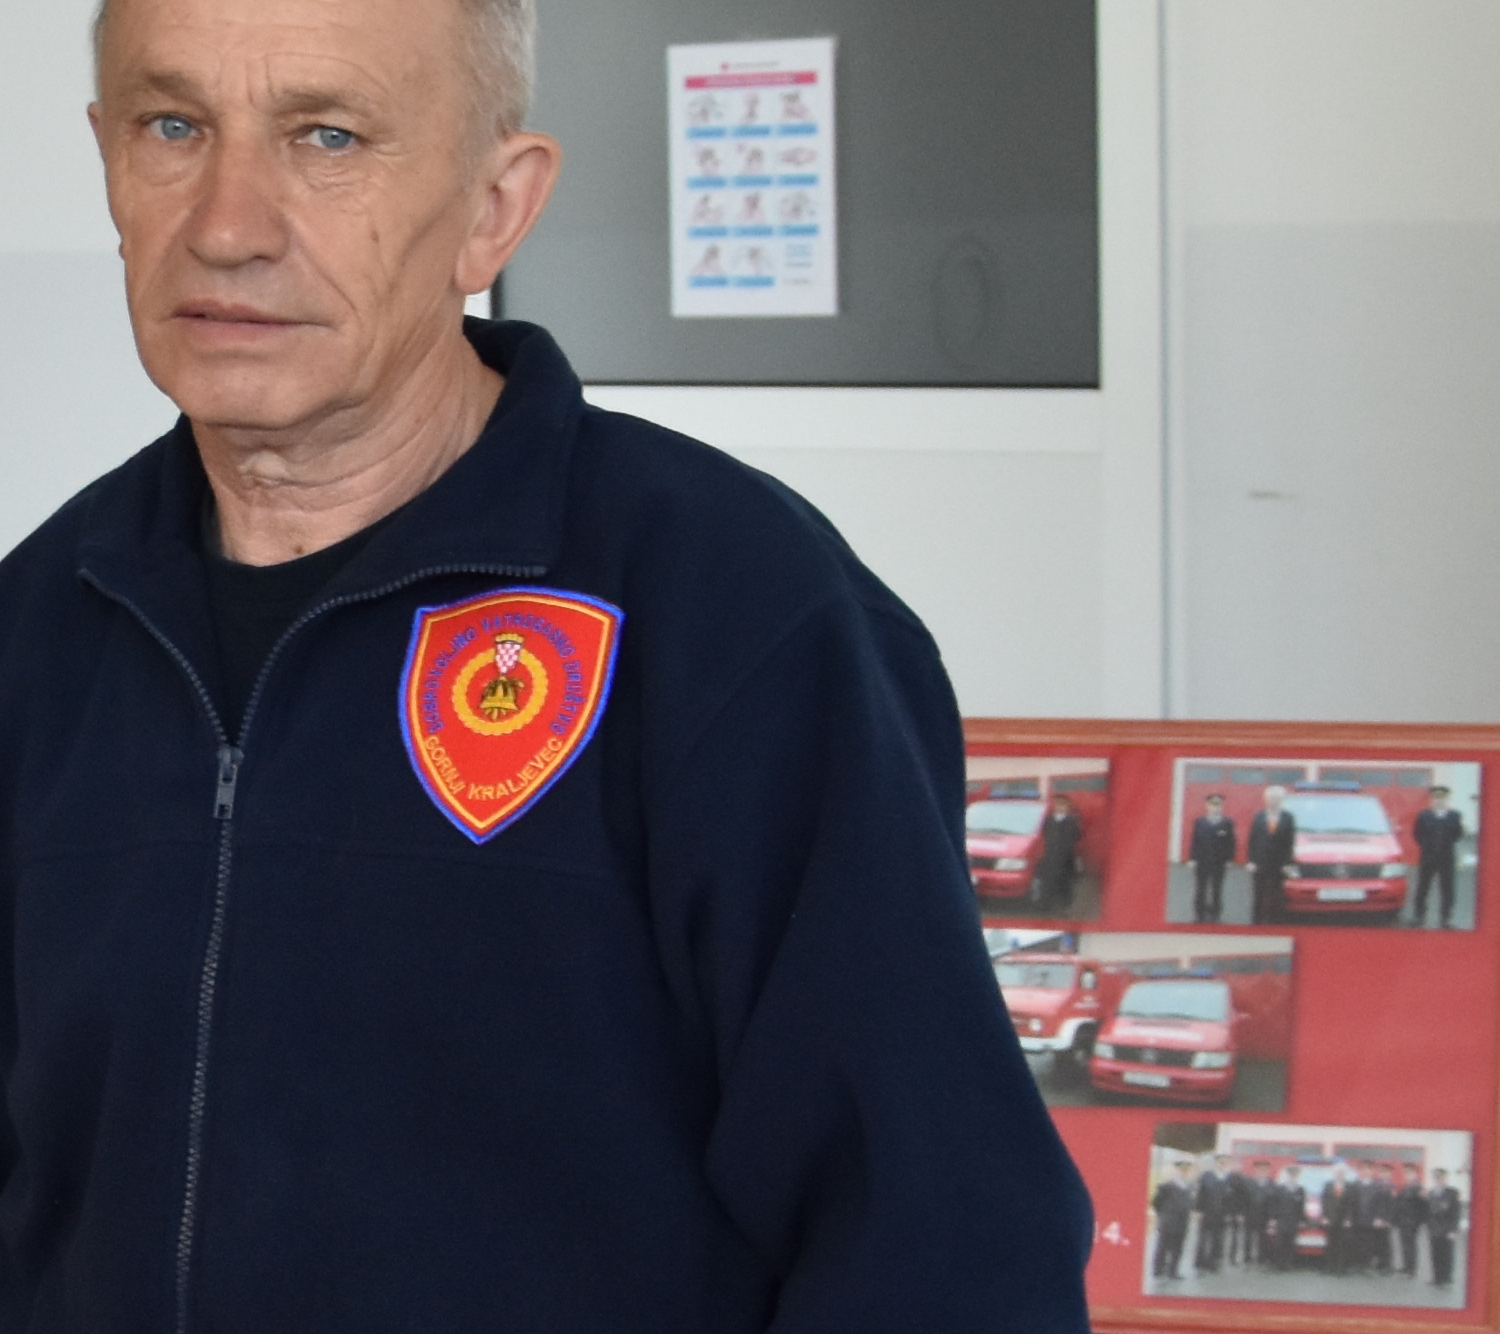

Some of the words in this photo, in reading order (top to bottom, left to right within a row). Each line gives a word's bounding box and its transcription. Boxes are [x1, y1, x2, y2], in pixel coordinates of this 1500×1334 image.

[481, 613, 577, 659] VATROGASNO
[424, 735, 466, 796] GORNJI
[468, 737, 562, 800] KRALJEVEC
